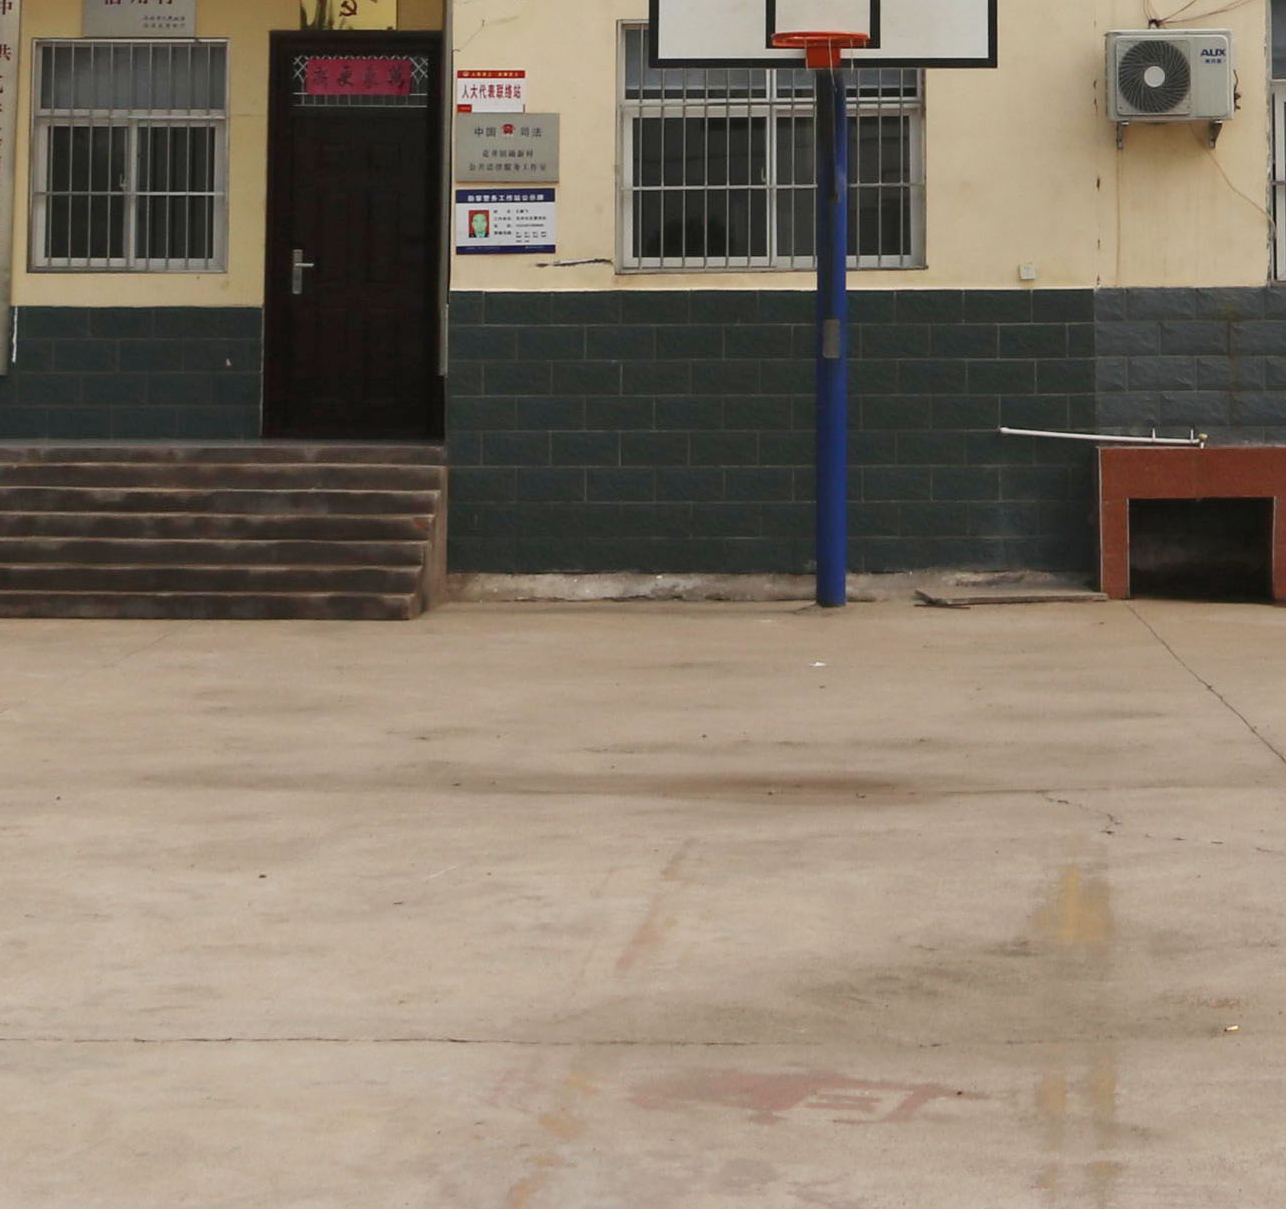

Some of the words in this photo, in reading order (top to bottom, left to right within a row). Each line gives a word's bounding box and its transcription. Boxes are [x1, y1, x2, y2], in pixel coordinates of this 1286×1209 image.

[1200, 48, 1227, 57] AUX
[462, 83, 522, 99] 人大代表联络站
[474, 127, 497, 137] 中国
